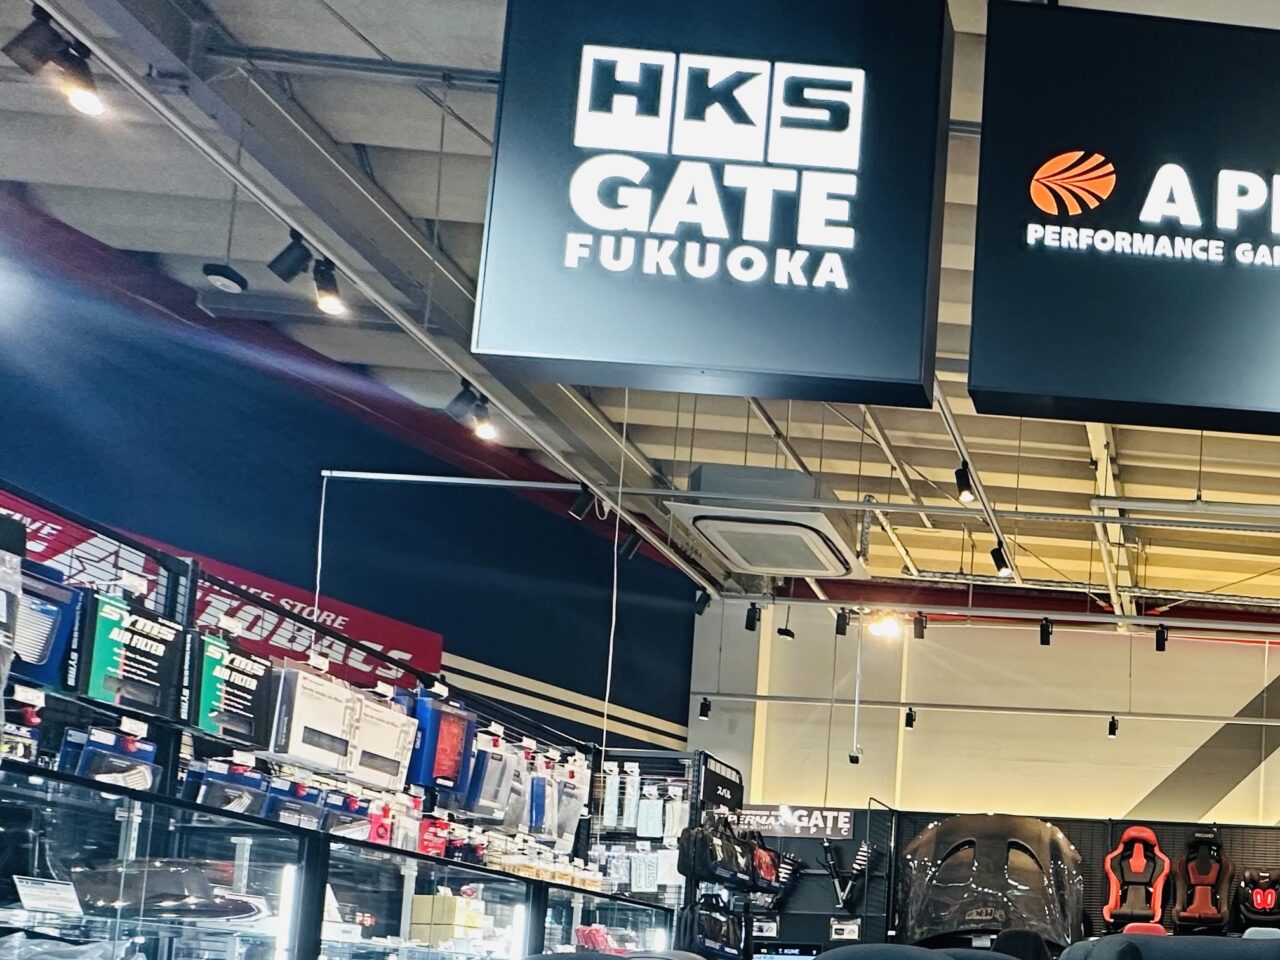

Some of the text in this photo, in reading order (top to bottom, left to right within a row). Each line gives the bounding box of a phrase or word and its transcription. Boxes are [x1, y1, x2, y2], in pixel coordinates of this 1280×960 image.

[578, 46, 866, 160] HKS
[569, 154, 857, 248] GATE
[1138, 162, 1201, 225] A
[565, 230, 850, 291] FUKUOKA
[1025, 222, 1224, 264] PERFORMANCE
[794, 809, 851, 829] GATE
